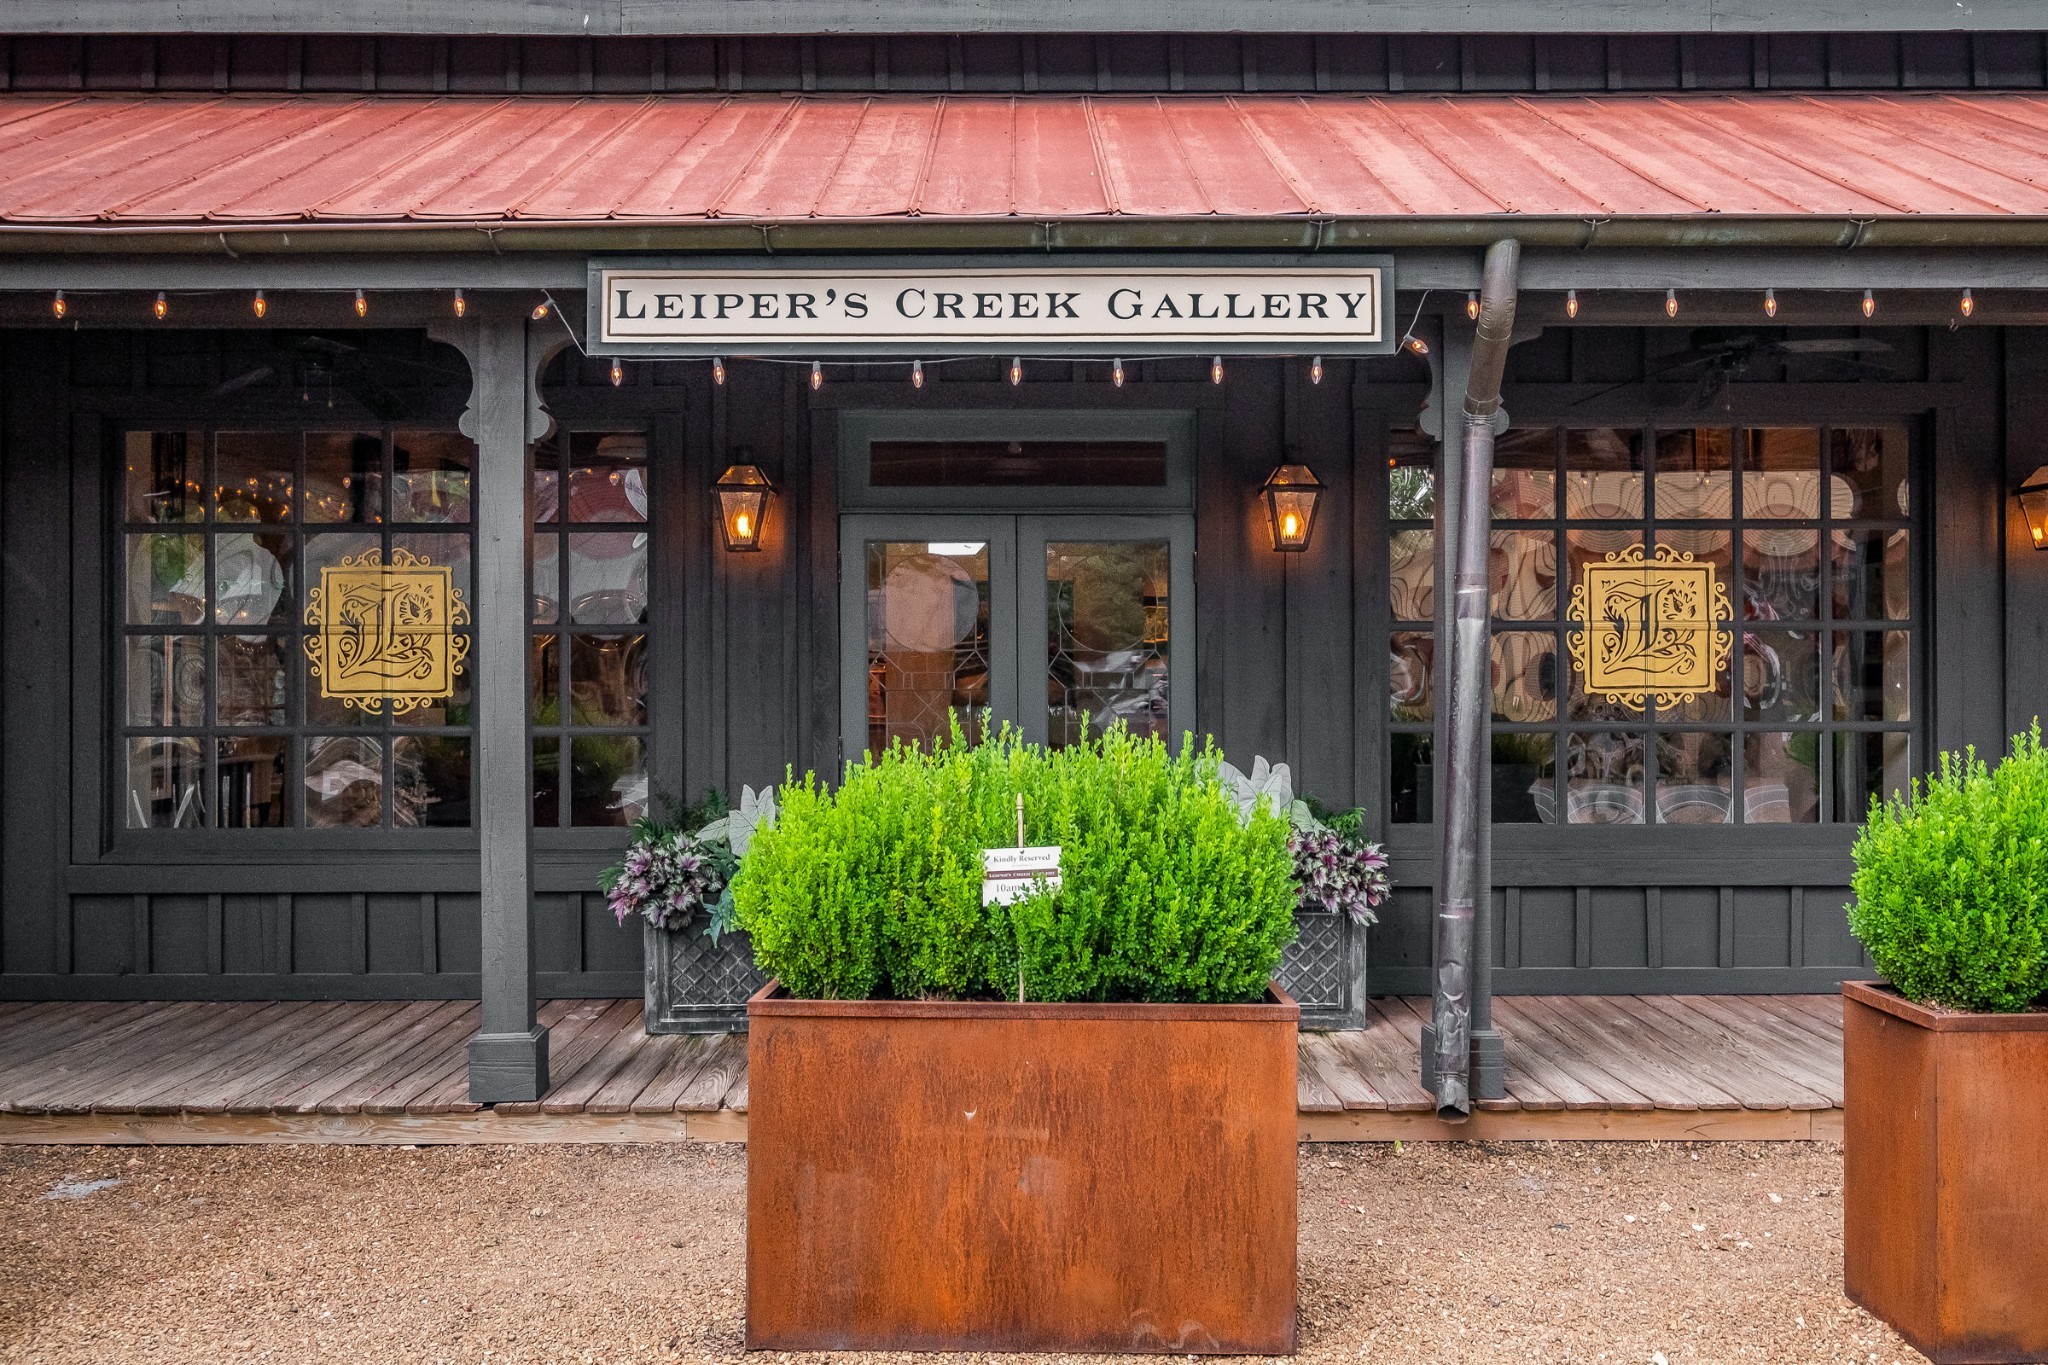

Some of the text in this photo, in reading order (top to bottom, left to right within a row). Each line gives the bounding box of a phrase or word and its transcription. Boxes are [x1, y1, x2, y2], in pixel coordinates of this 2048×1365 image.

[614, 287, 1367, 320] LEIPER'S CREEK GALLERY
[993, 853, 1051, 864] Kindly Reserved
